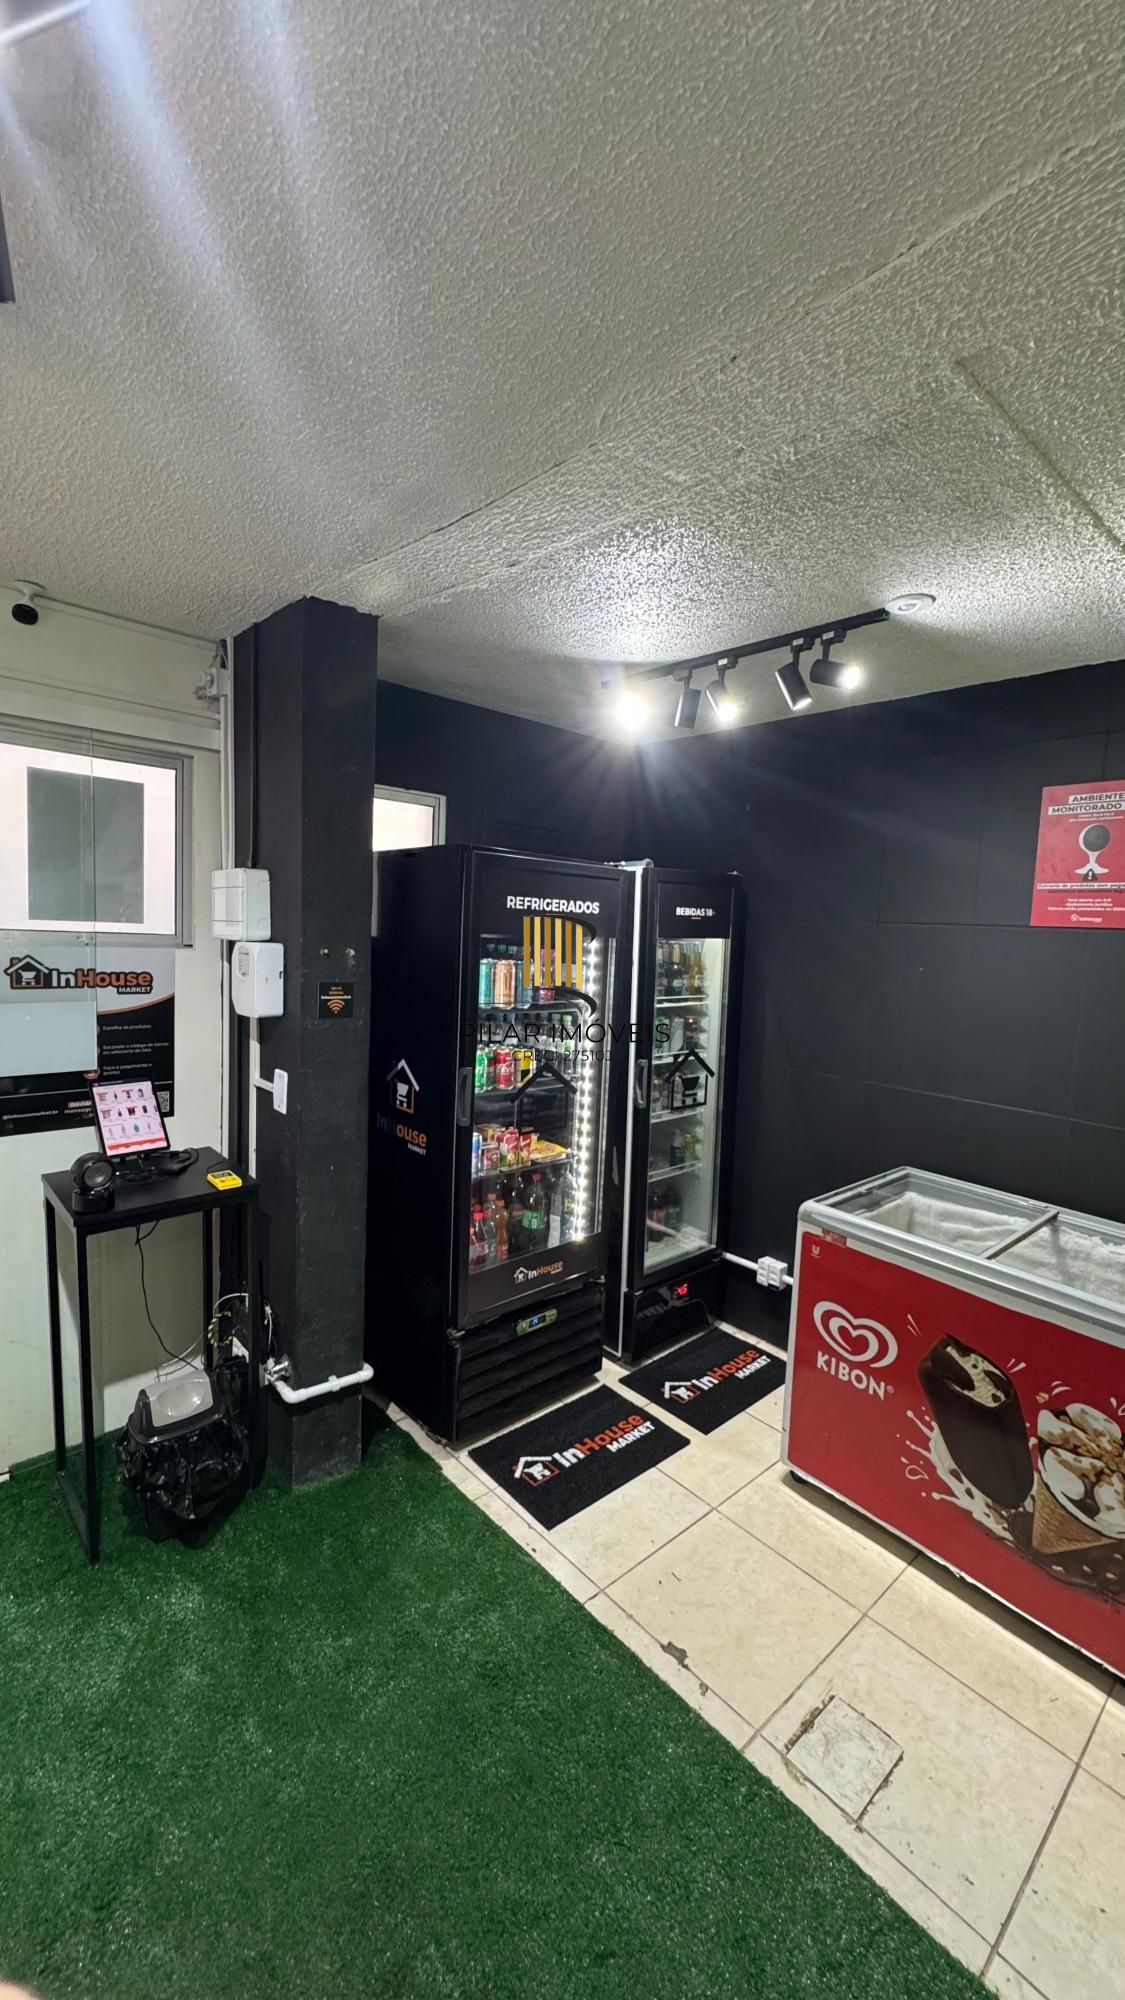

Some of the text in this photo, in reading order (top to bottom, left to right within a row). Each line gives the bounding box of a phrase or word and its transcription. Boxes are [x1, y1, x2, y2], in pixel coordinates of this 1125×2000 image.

[1072, 792, 1125, 803] AMBIENTE
[1052, 803, 1122, 814] MONITORADO
[507, 896, 600, 914] REFRIGERADOS
[676, 907, 705, 916] BEBIDAS
[51, 969, 152, 988] InHouse
[376, 1112, 427, 1147] Inouse
[528, 1261, 564, 1278] InHouse
[691, 1348, 760, 1391] InHouse
[734, 1355, 771, 1380] MARKET
[552, 1414, 645, 1468] InHouse
[606, 1421, 656, 1453] MARKET
